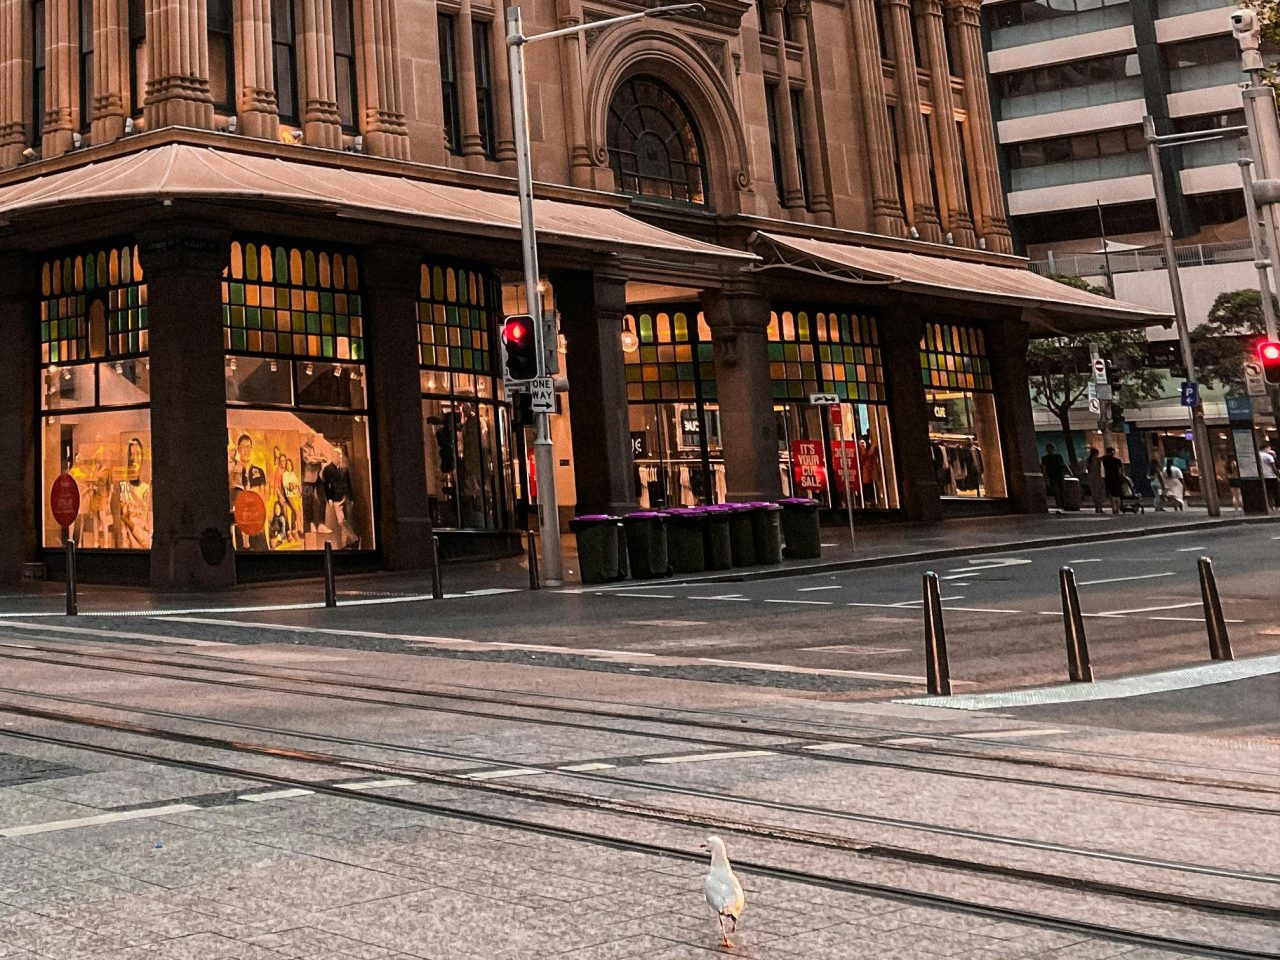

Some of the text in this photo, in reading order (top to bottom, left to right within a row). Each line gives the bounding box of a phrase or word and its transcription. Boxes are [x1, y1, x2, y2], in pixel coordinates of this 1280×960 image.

[532, 380, 550, 389] ONE
[531, 390, 553, 400] WAY
[1185, 387, 1194, 397] P
[800, 443, 815, 455] IT'S
[798, 455, 819, 466] YOUR
[801, 476, 822, 487] SALE
